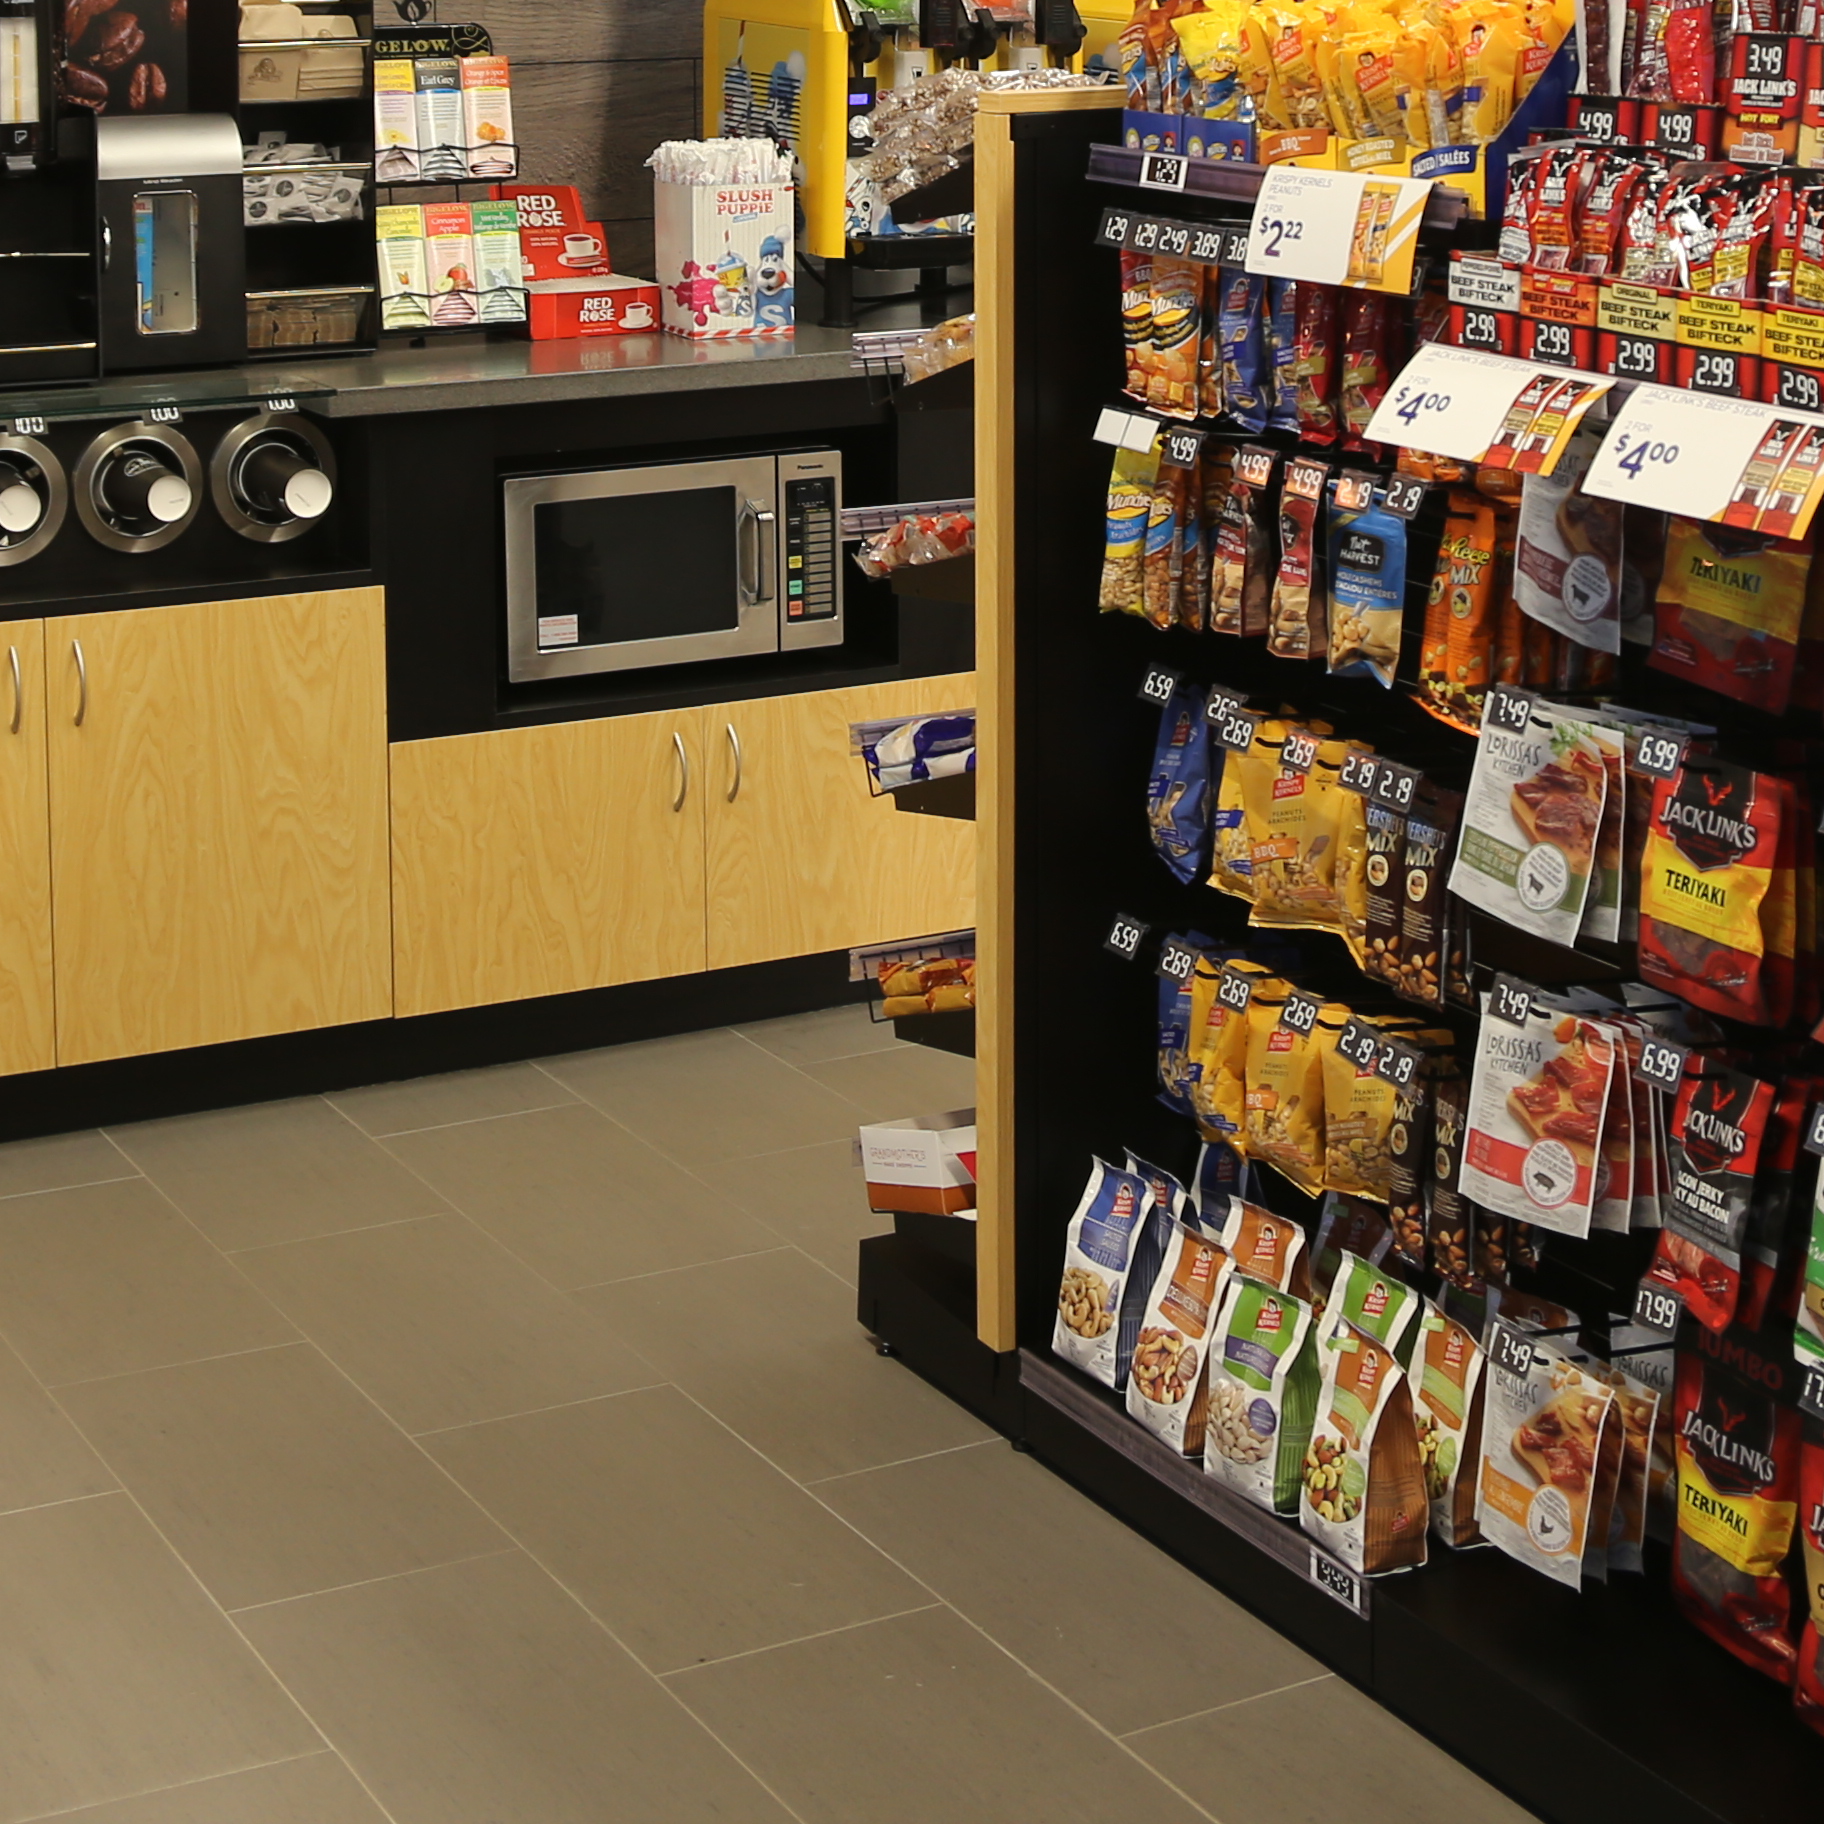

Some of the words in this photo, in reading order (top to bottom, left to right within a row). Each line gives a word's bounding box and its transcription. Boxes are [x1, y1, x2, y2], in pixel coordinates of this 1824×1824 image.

[1748, 44, 1782, 74] 3.49
[516, 195, 556, 210] RED
[717, 189, 773, 203] SLUSH
[516, 211, 563, 227] ROSE
[1104, 217, 1128, 241] 1.29
[1158, 227, 1188, 254] 2.49
[1191, 232, 1221, 259] 3.89
[583, 297, 612, 310] RED
[579, 309, 614, 322] ROSE
[1679, 315, 1712, 329] BEEF
[1715, 319, 1756, 336] STEAK
[1688, 328, 1743, 346] BIFTECK
[1697, 355, 1734, 389] 2.99
[1486, 733, 1542, 766] LORISSA'S
[1665, 869, 1727, 908] TERIYAKI
